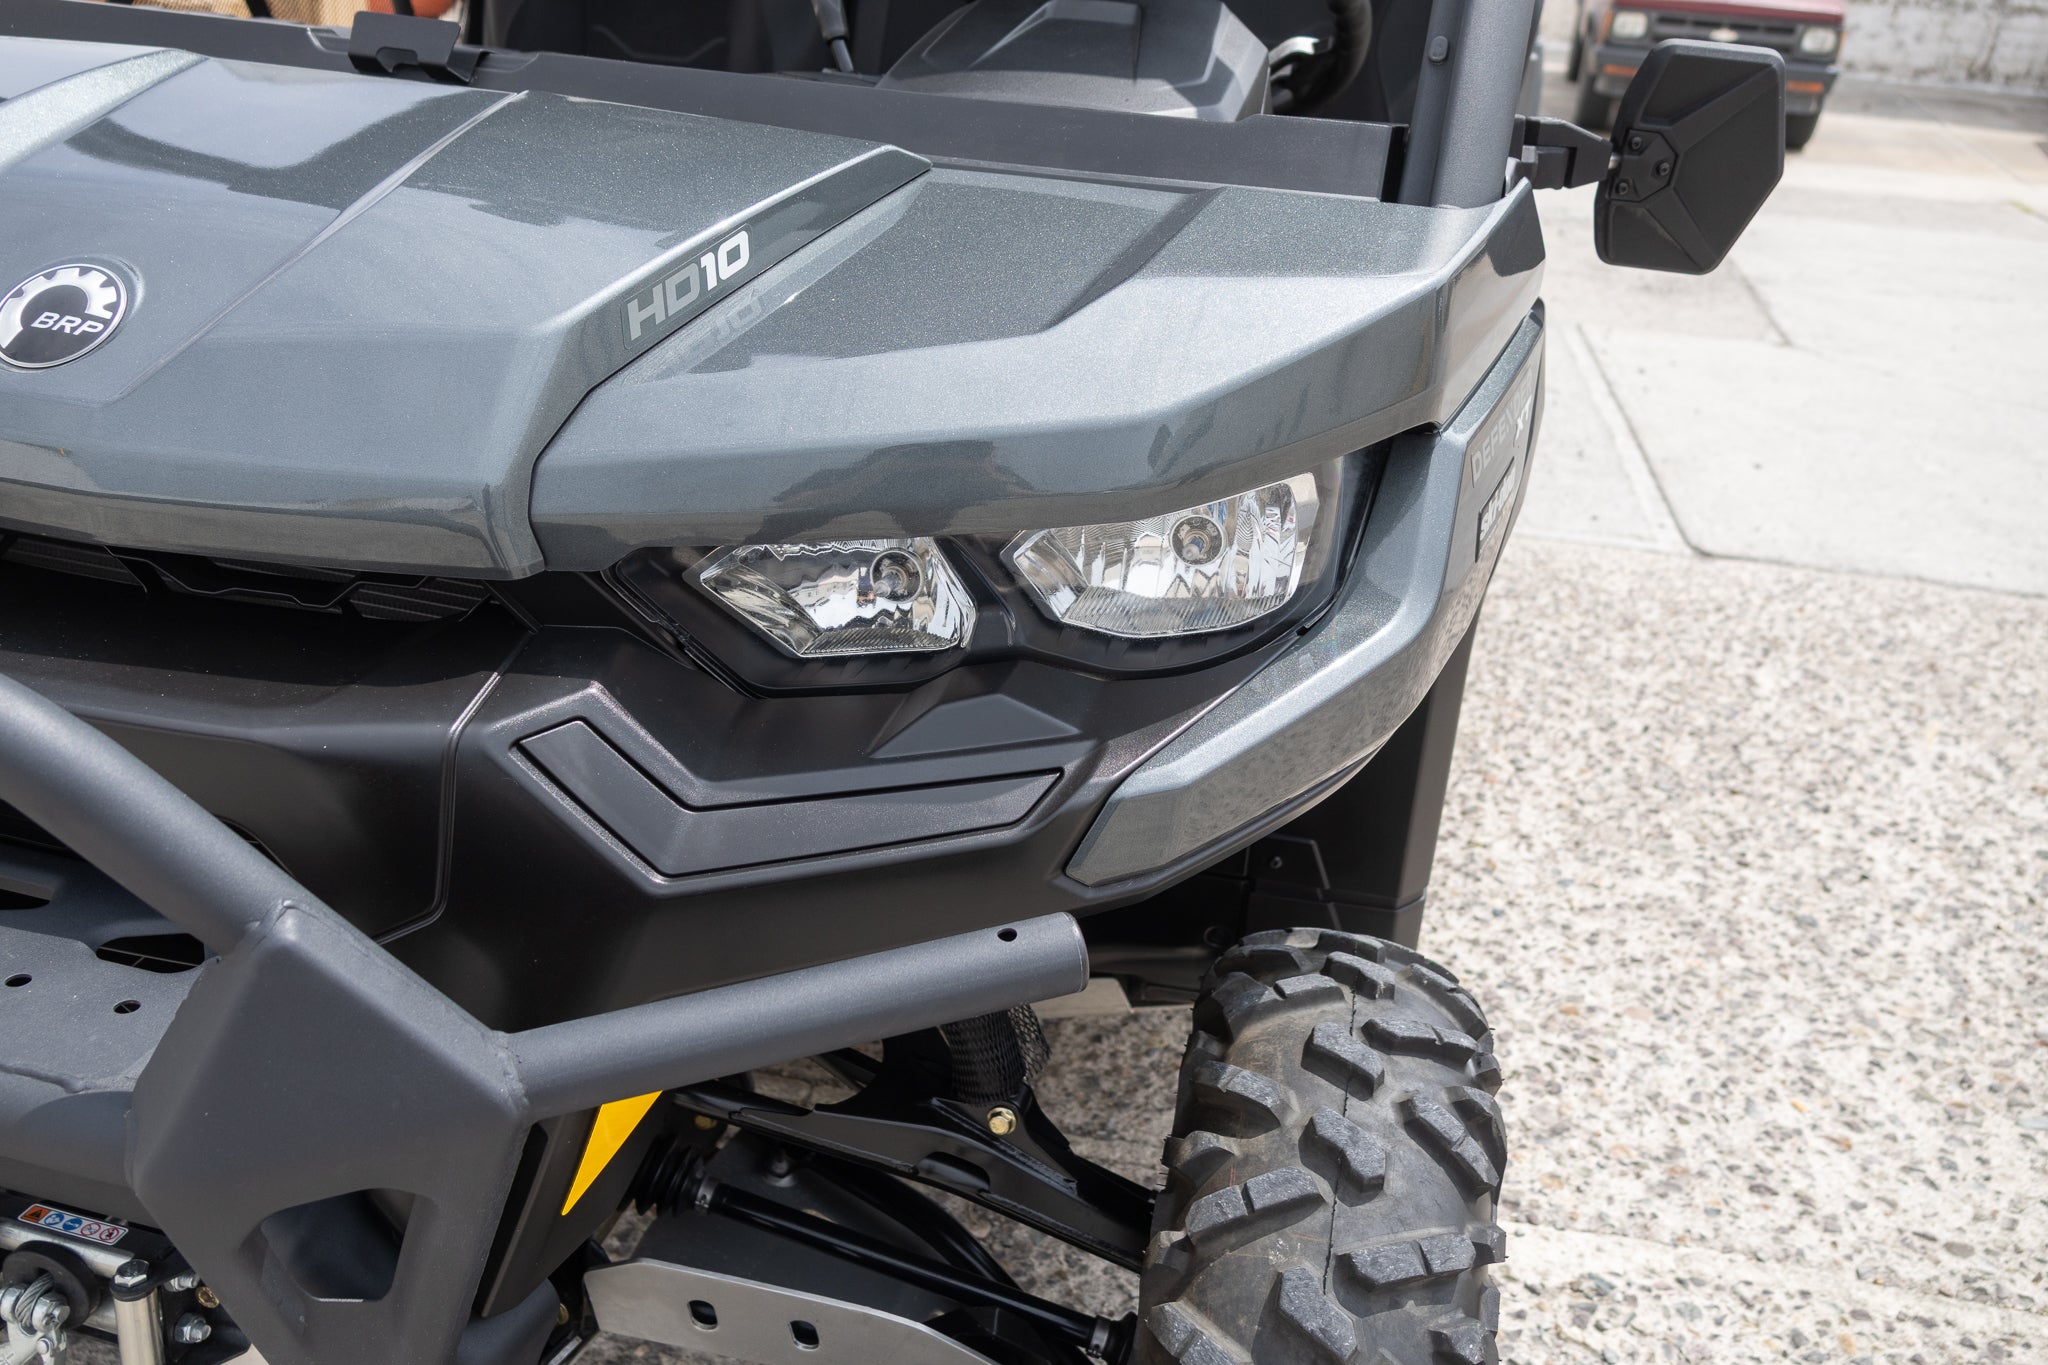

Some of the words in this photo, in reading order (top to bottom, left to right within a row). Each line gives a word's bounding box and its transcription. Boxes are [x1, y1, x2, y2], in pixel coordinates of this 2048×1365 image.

[30, 311, 105, 336] BRP
[627, 230, 750, 341] HD10
[1471, 366, 1533, 482] DEFENDER
